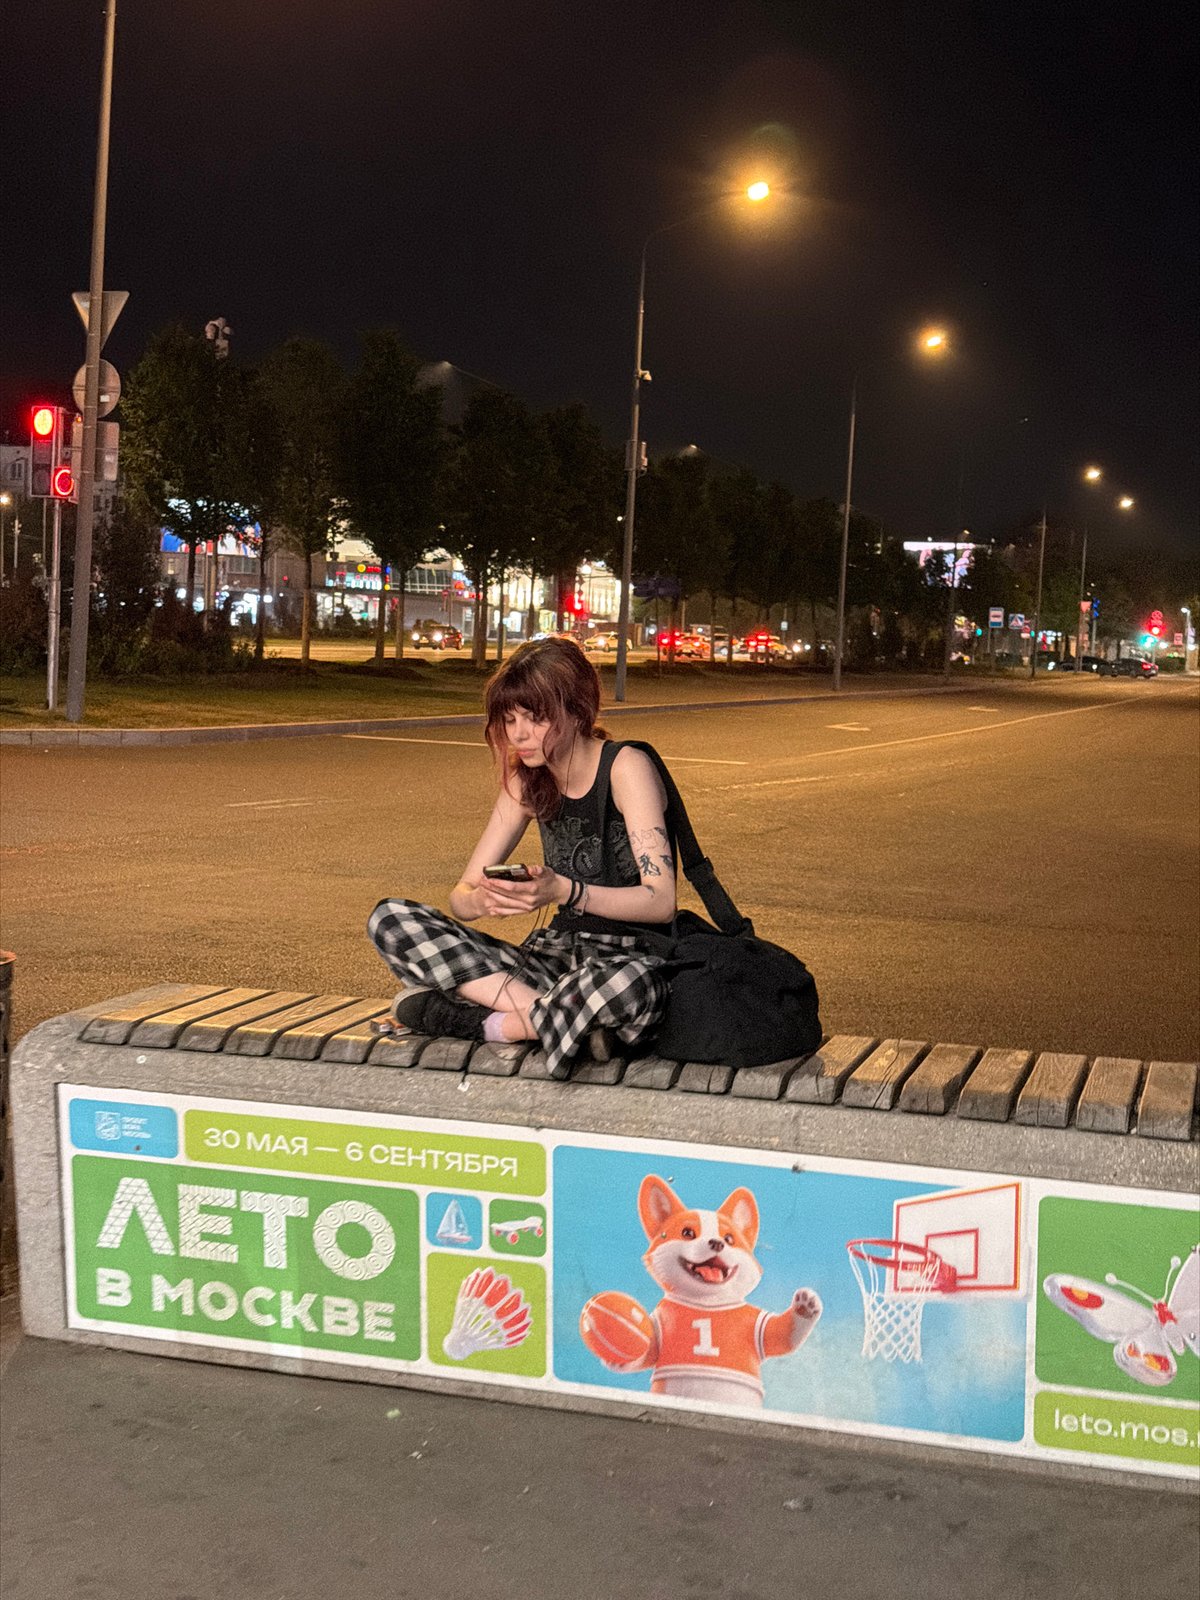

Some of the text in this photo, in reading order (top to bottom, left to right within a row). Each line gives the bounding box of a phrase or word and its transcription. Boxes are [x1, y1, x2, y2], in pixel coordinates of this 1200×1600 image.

[203, 1127, 240, 1149] 30
[246, 1132, 309, 1156] МАЯ
[345, 1141, 363, 1162] 6
[369, 1144, 518, 1177] СЕНТЯБРЯ
[96, 1176, 397, 1281] ЛЕТО
[96, 1267, 397, 1342] В МОСКВЕ
[691, 1317, 720, 1357] 1
[1054, 1408, 1200, 1448] leto.mos.
